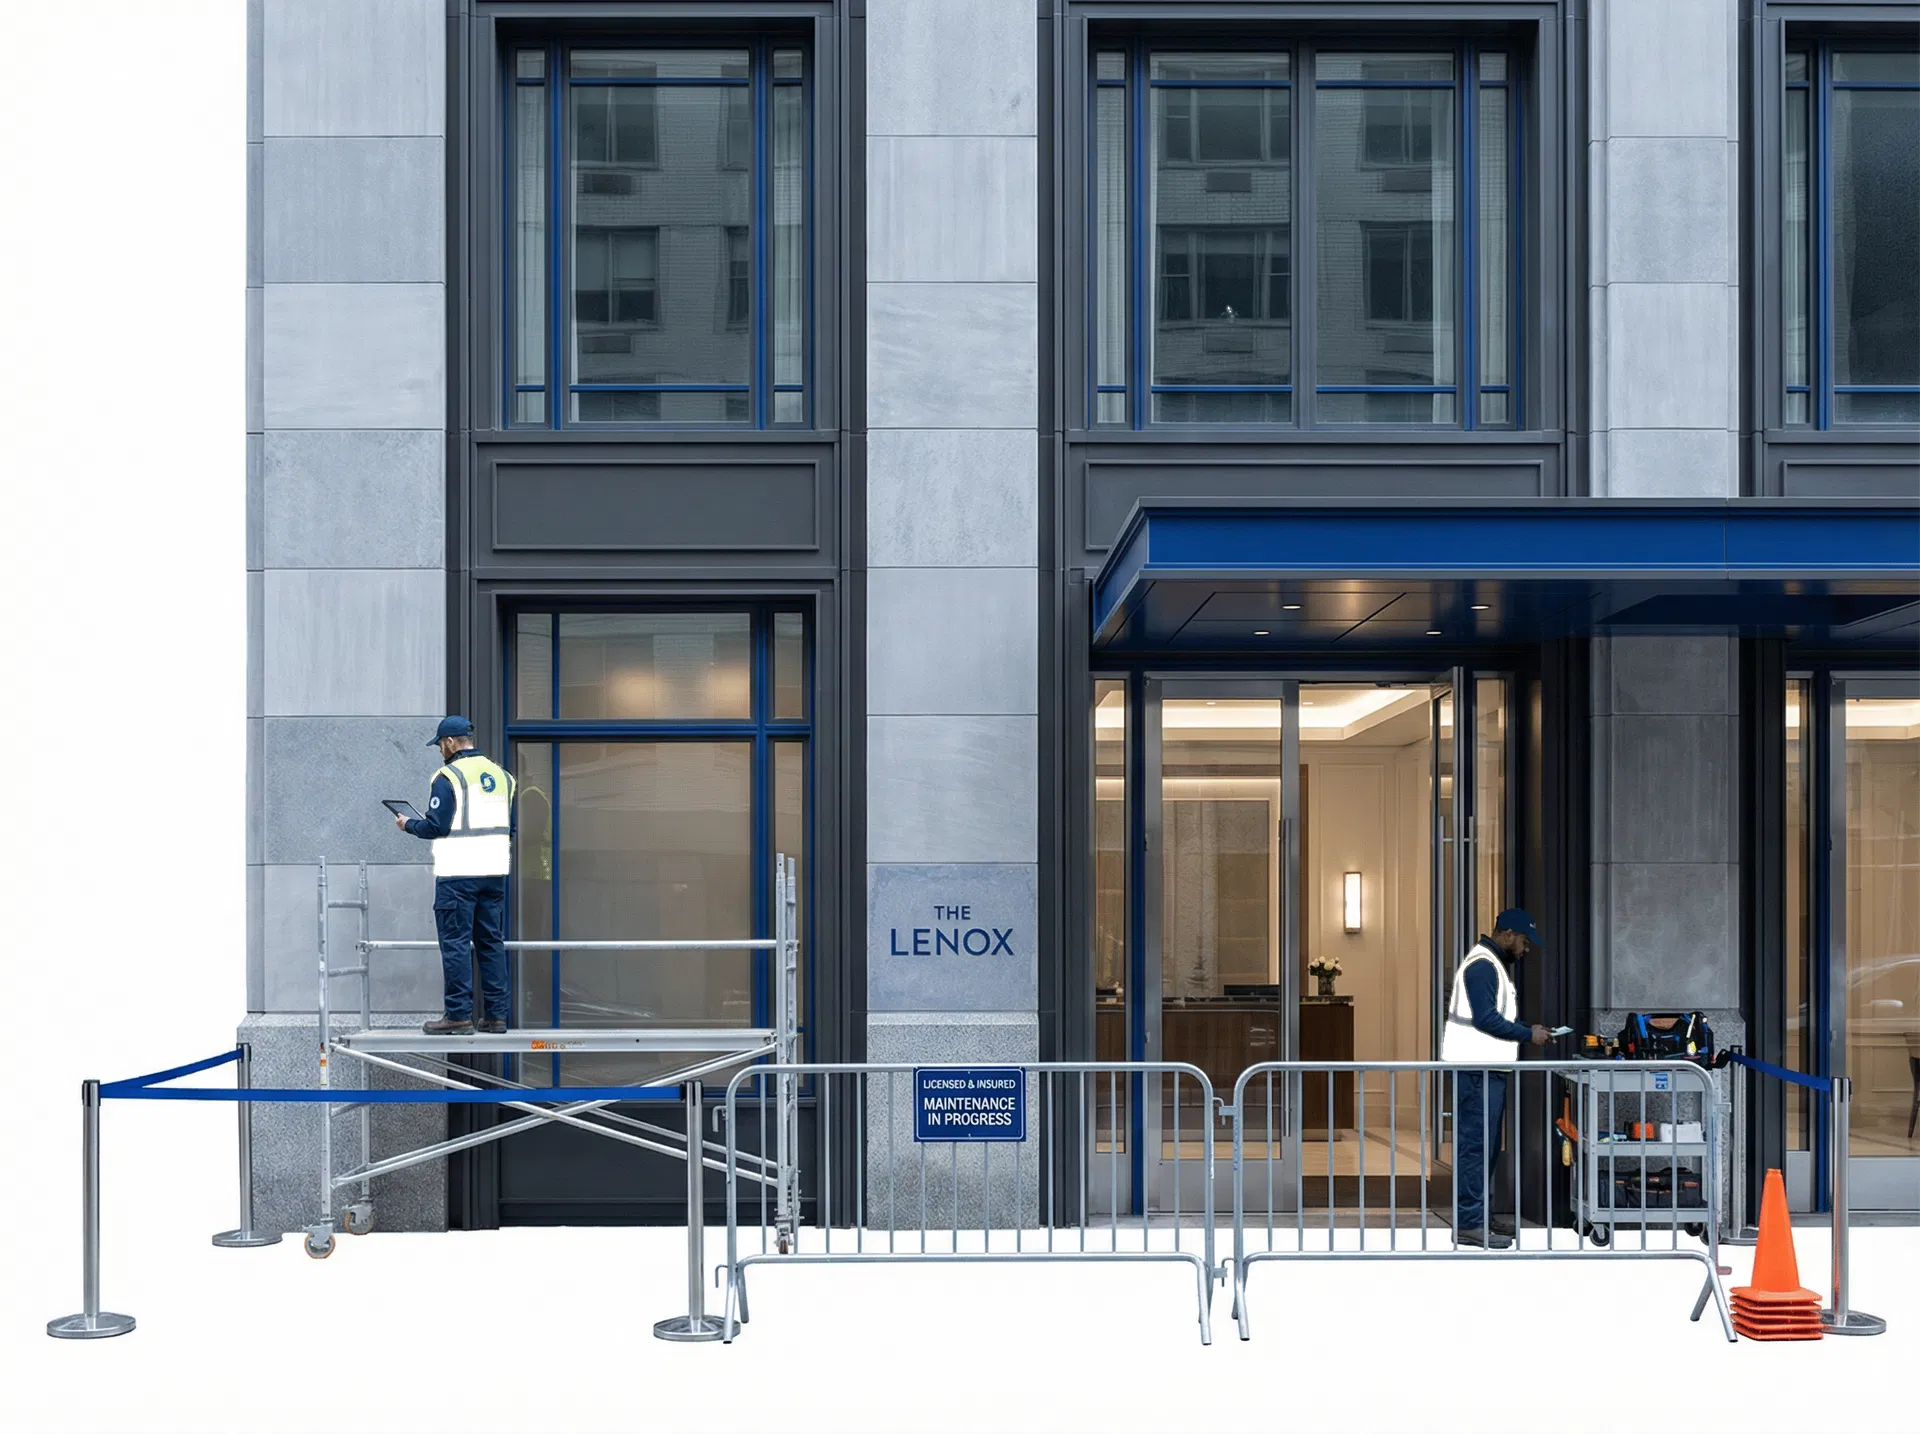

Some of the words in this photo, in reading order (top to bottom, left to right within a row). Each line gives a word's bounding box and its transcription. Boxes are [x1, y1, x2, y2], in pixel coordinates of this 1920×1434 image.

[933, 905, 971, 920] THE
[890, 928, 1015, 956] LENOX
[923, 1079, 966, 1089] LICENSED
[967, 1079, 975, 1089] &
[976, 1079, 1016, 1089] INSURED
[923, 1097, 1016, 1110] MAINTENANCE
[928, 1112, 941, 1126] IN
[944, 1112, 1012, 1126] PROGRESS
